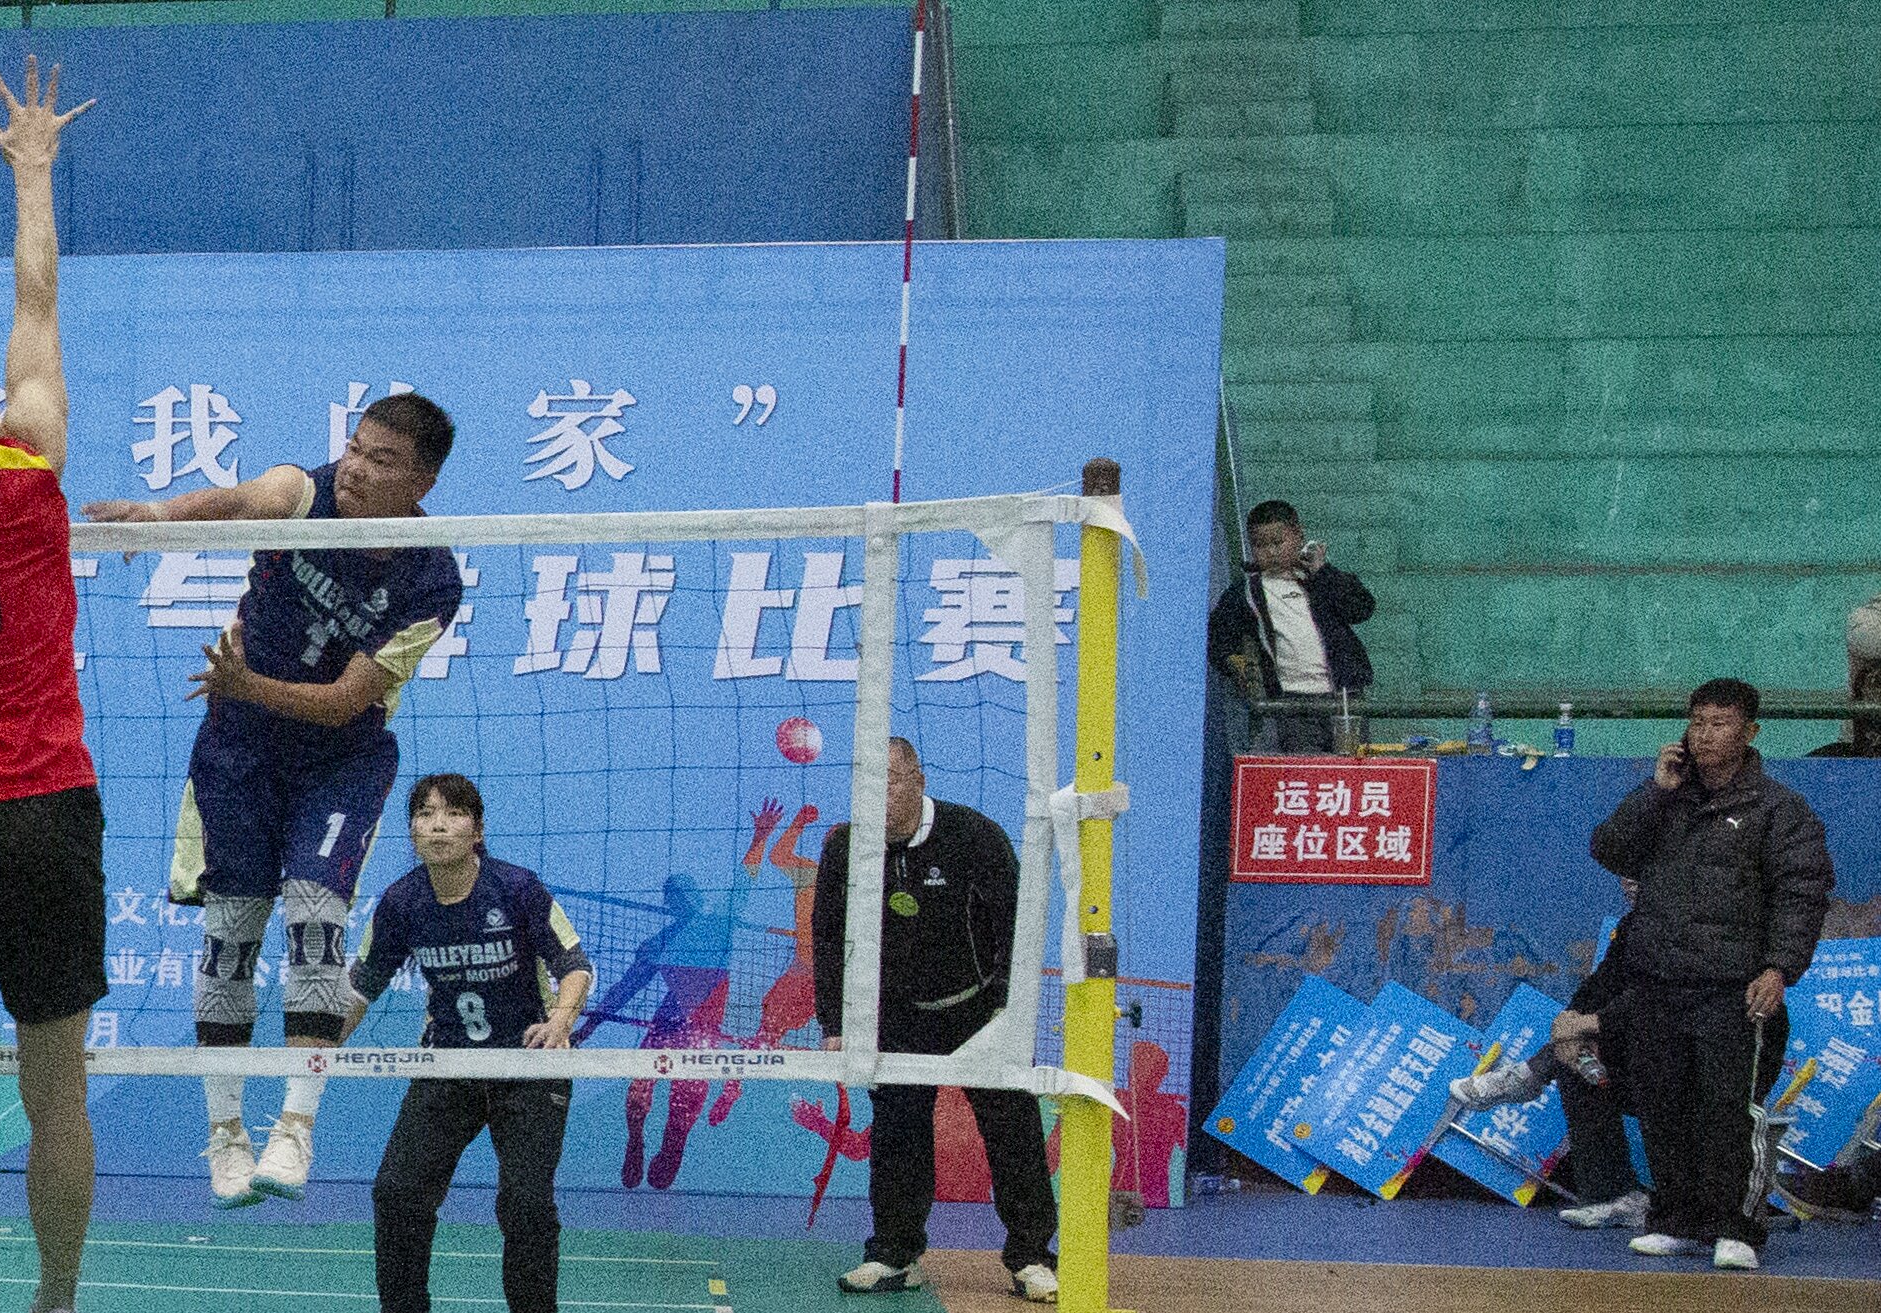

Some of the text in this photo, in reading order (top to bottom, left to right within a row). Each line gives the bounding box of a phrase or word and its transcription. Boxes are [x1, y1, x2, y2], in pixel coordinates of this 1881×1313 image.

[1273, 779, 1392, 818] 运动员
[317, 811, 347, 859] 1
[1250, 823, 1413, 863] 座位区域
[455, 991, 493, 1042] 8
[333, 1051, 436, 1065] HENGJIA
[680, 1052, 786, 1066] HENGJIA
[1337, 1023, 1458, 1168] 湘乡金融监管支局队
